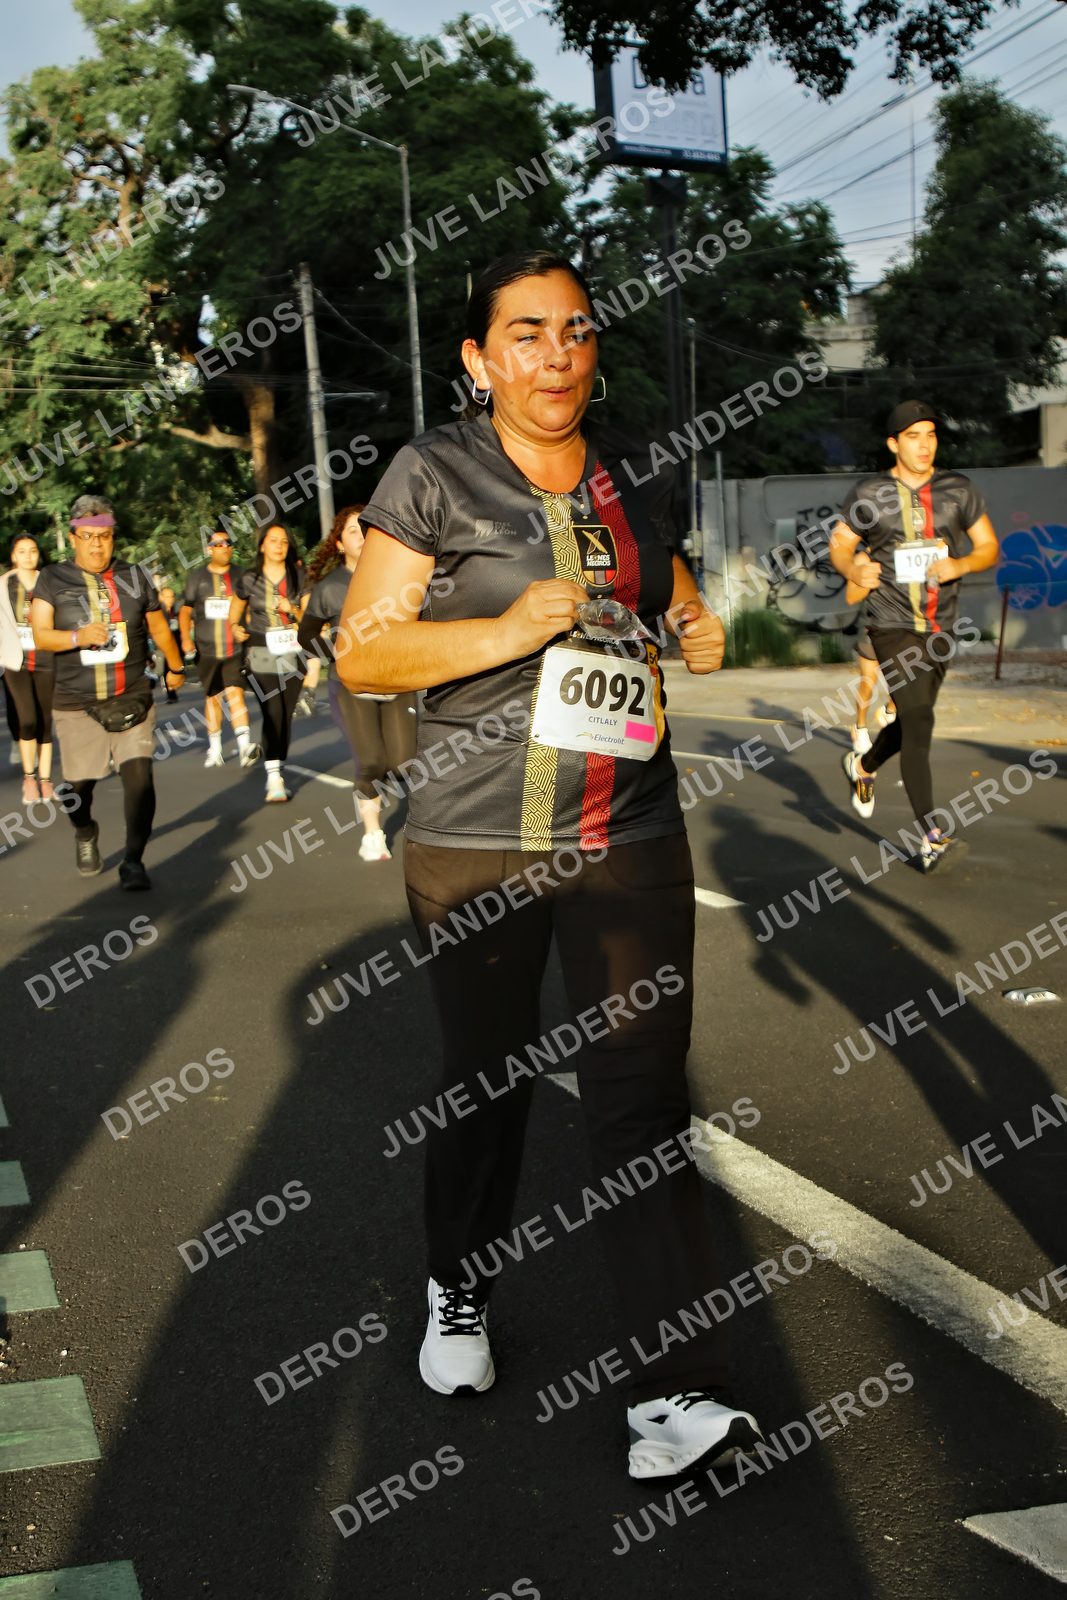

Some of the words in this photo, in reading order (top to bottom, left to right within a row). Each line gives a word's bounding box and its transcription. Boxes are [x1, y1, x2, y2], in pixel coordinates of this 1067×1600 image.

[560, 666, 646, 717] 6092
[588, 714, 618, 726] CITLALY
[593, 733, 625, 745] Electrolit
